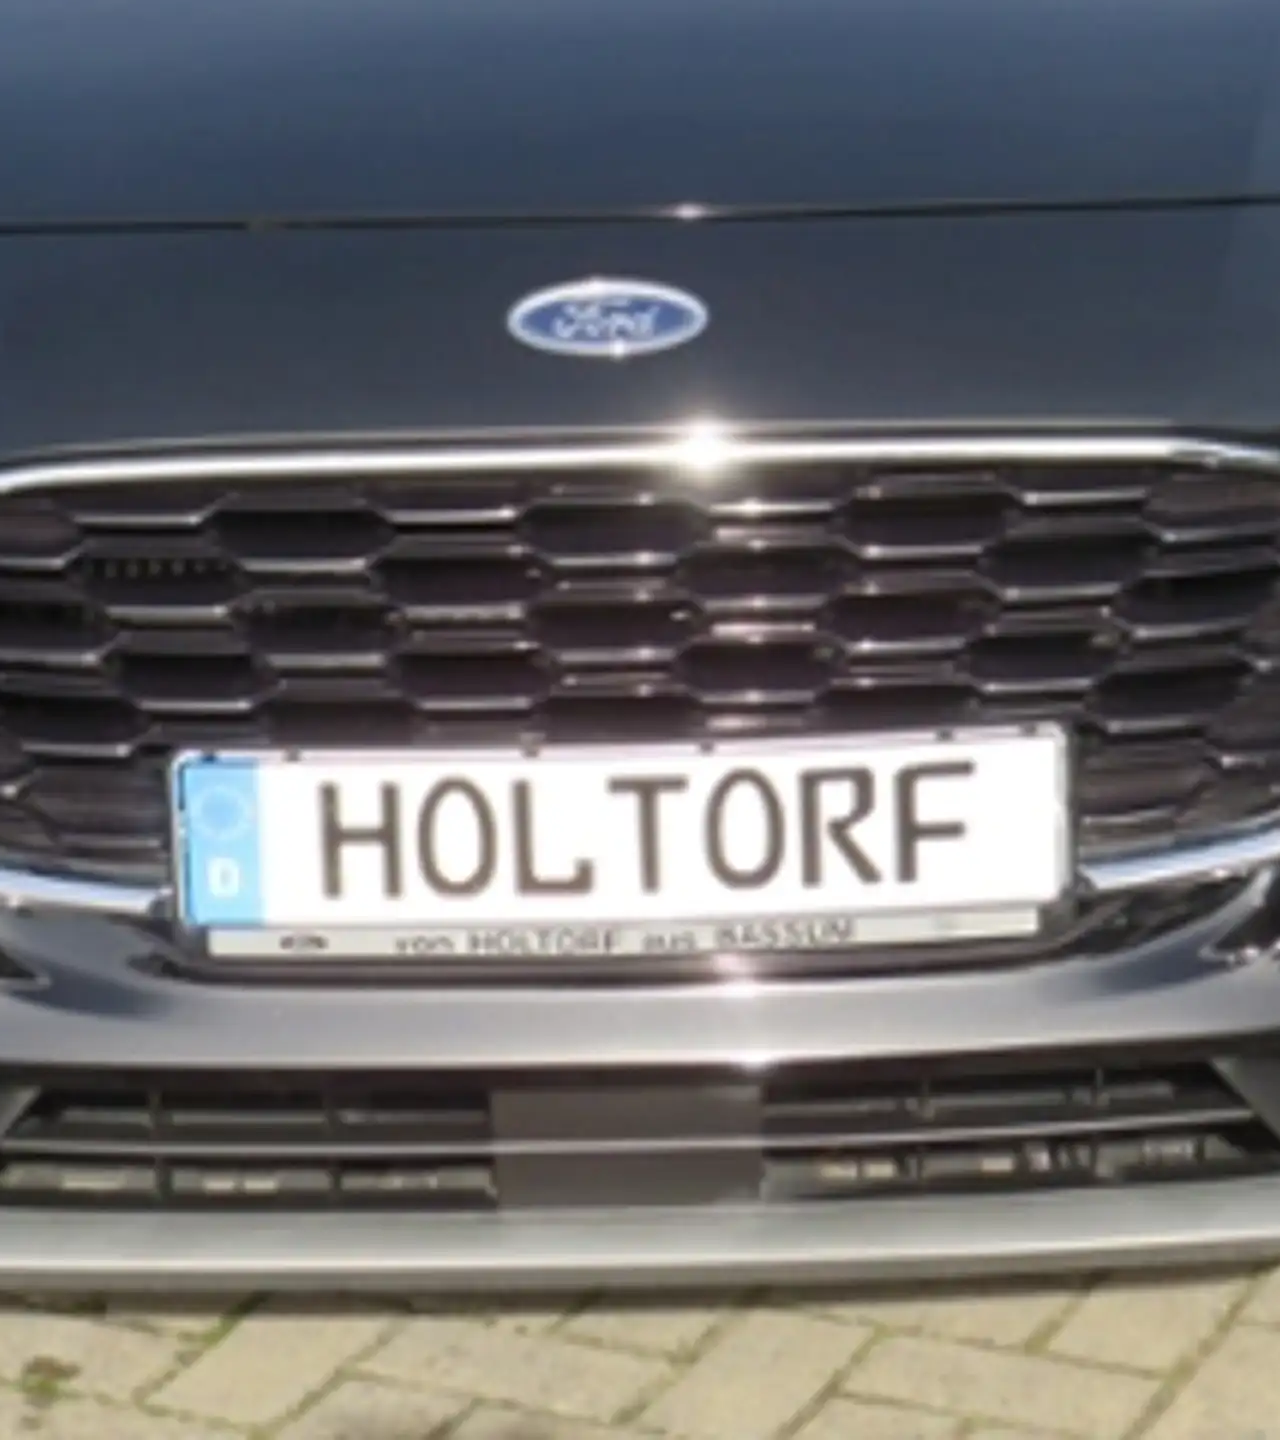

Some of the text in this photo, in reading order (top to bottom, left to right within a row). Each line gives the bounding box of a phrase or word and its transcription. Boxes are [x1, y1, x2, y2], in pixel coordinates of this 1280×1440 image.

[550, 297, 662, 340] Ford
[206, 761, 976, 901] D HOLTORF
[395, 933, 457, 955] von
[470, 927, 616, 956] HOLTORF
